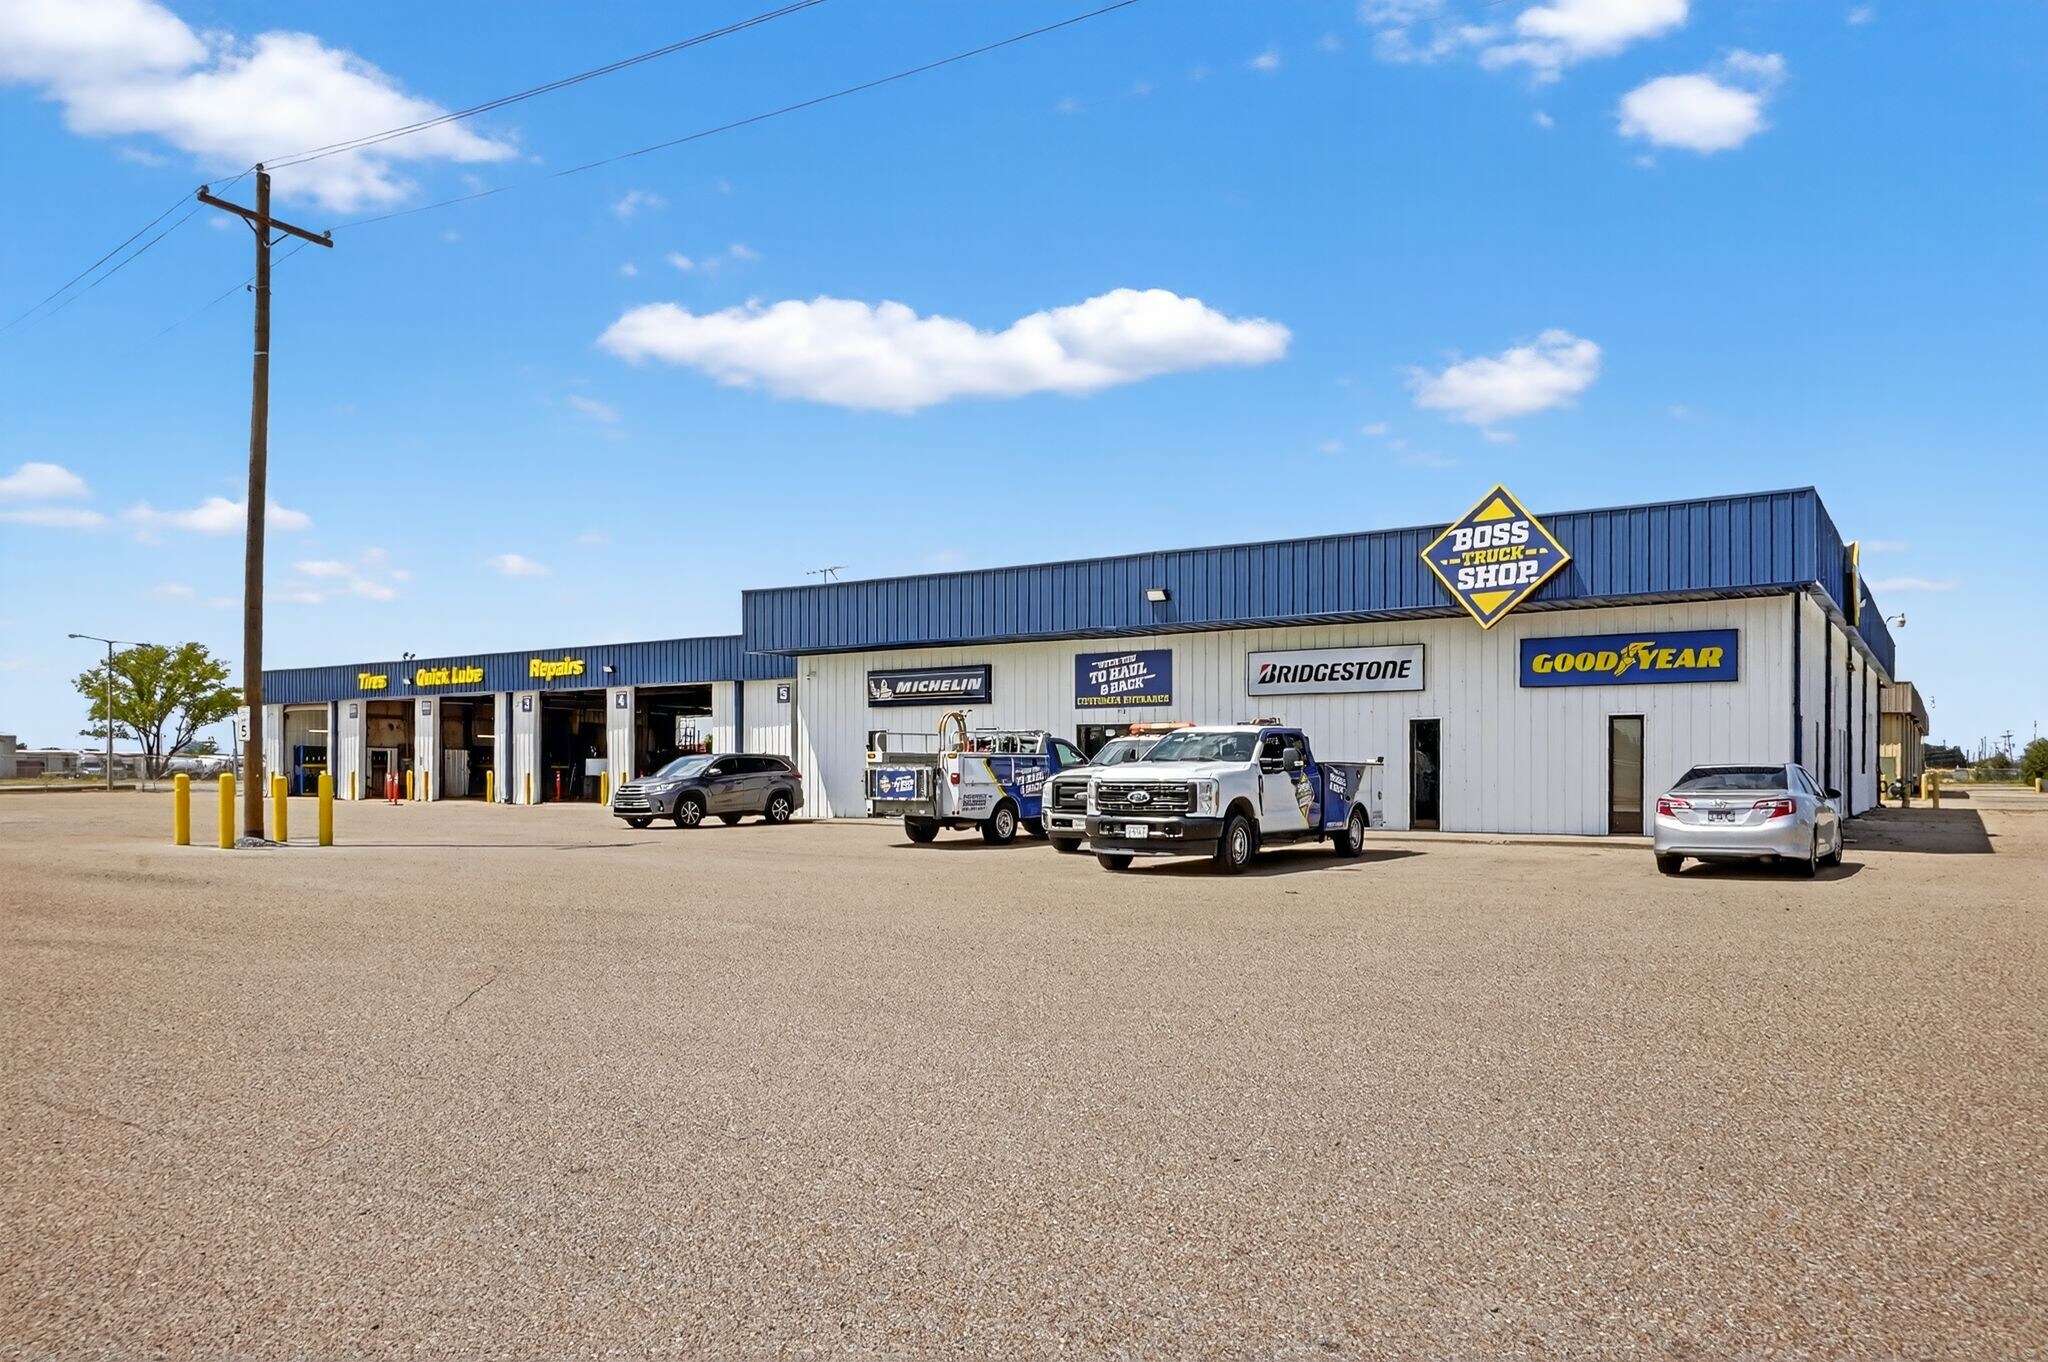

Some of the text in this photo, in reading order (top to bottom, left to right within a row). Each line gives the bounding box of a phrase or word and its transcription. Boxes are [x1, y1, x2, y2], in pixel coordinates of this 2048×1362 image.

[1448, 520, 1530, 552] BOSS
[1461, 545, 1526, 566] TRUCK
[1457, 559, 1539, 590] SHOP
[416, 665, 484, 687] Quick Lube
[529, 656, 585, 681] Repairs
[1089, 661, 1147, 684] TO HAUL
[1258, 659, 1412, 685] BRIDGESTONE
[358, 672, 388, 690] Tires
[895, 677, 982, 694] MICHELIN
[1109, 677, 1146, 694] BACK
[523, 698, 530, 710] 3
[618, 694, 625, 706] 4
